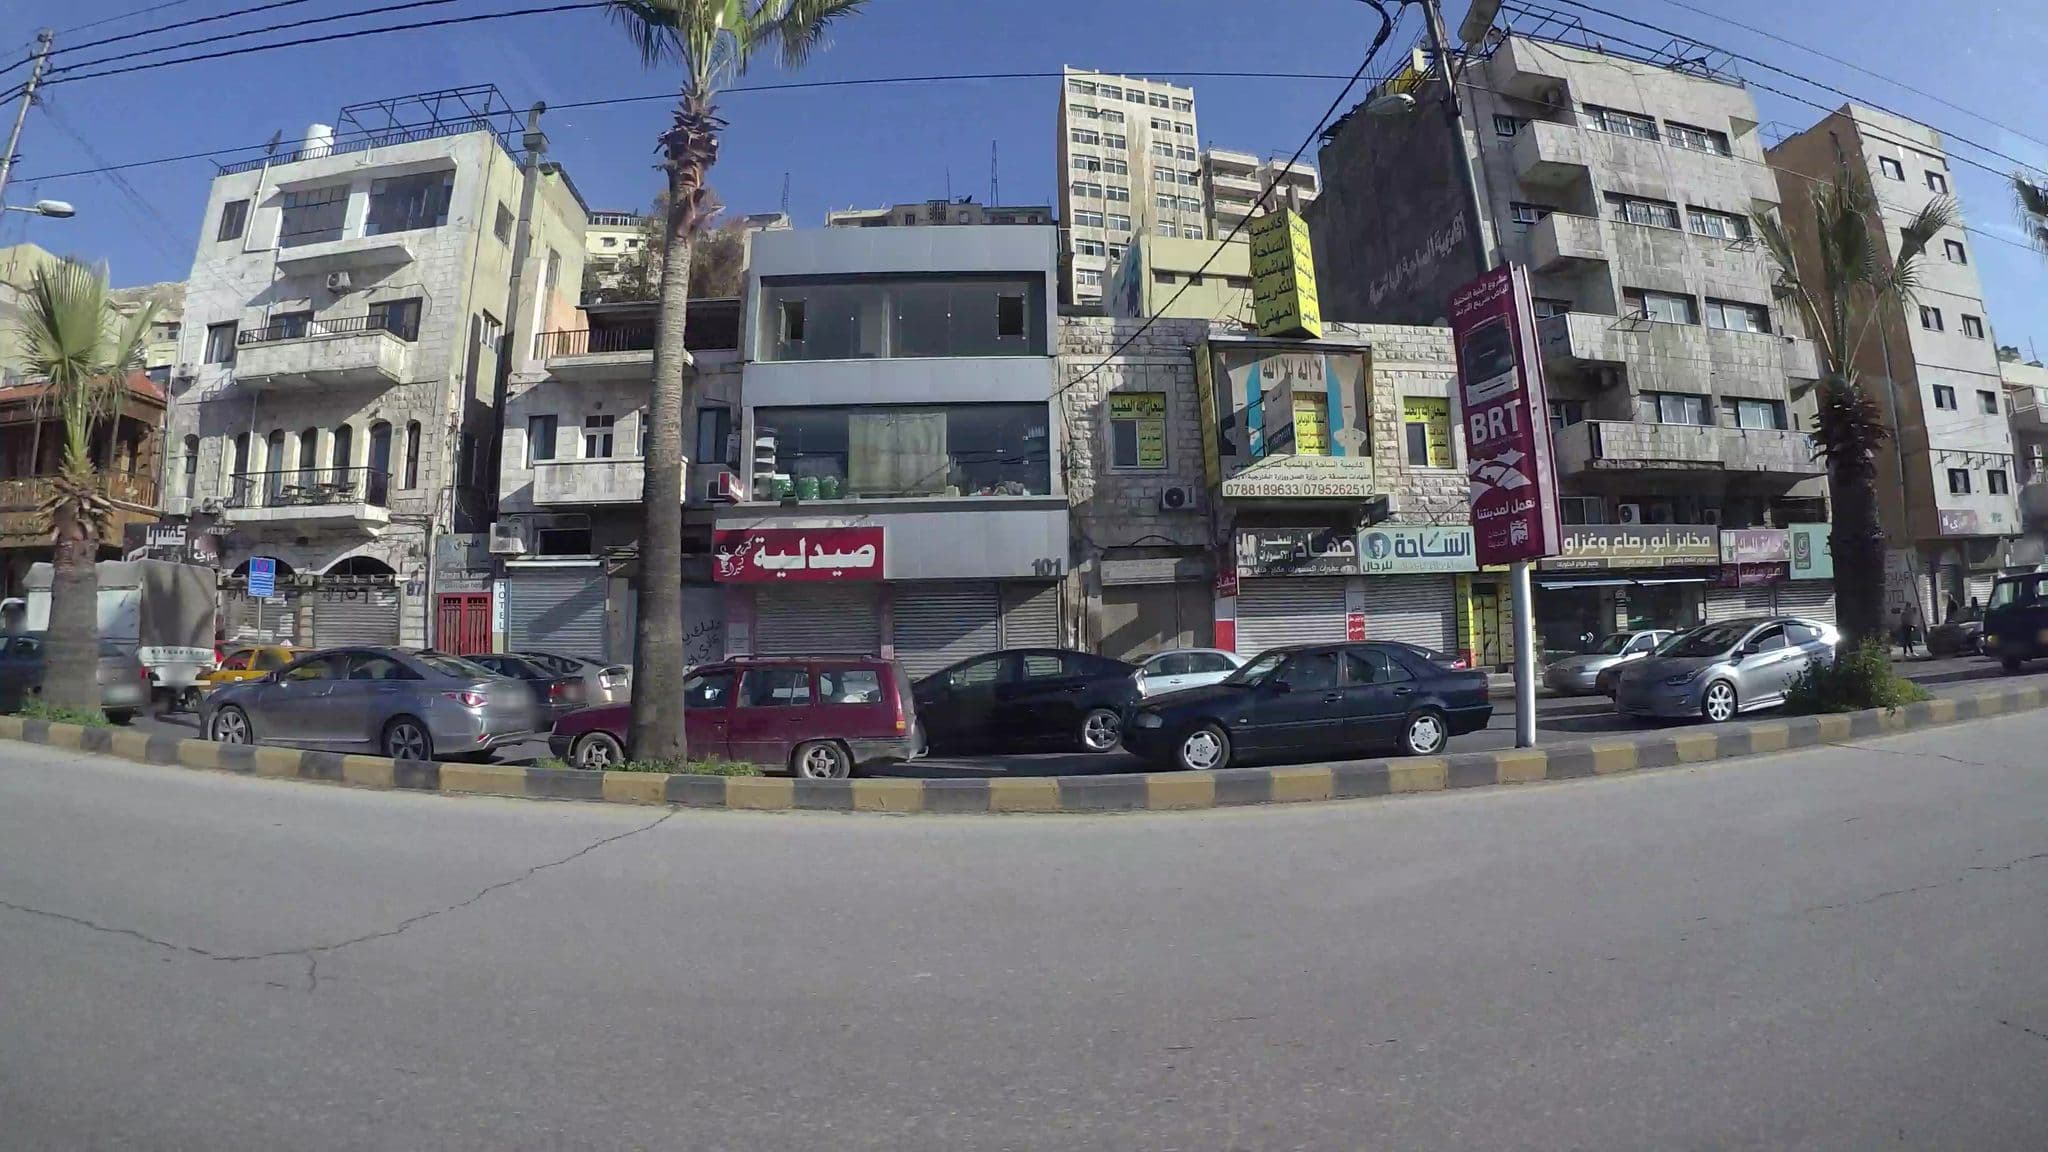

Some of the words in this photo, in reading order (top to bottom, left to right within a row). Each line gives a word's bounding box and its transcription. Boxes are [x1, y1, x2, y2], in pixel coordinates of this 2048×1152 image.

[1253, 236, 1288, 257] الساحة
[1253, 255, 1292, 282] الهاشمية
[1488, 274, 1508, 291] مشروع
[1261, 302, 1296, 332] المهني
[1470, 399, 1521, 445] BRT
[1226, 484, 1299, 496] 0788189633
[1303, 483, 1374, 496] 0795262512
[1477, 501, 1509, 520] لمدينتنا
[1296, 533, 1356, 562] جهاد
[1394, 531, 1471, 558] الساحة
[1564, 532, 1607, 555] وغزاو
[1613, 532, 1647, 555] رصاع
[1651, 528, 1670, 553] أبو
[1675, 532, 1711, 552] مخابز
[753, 536, 876, 578] صيدلية
[1031, 557, 1062, 577] 101
[1362, 561, 1393, 573] للرجال
